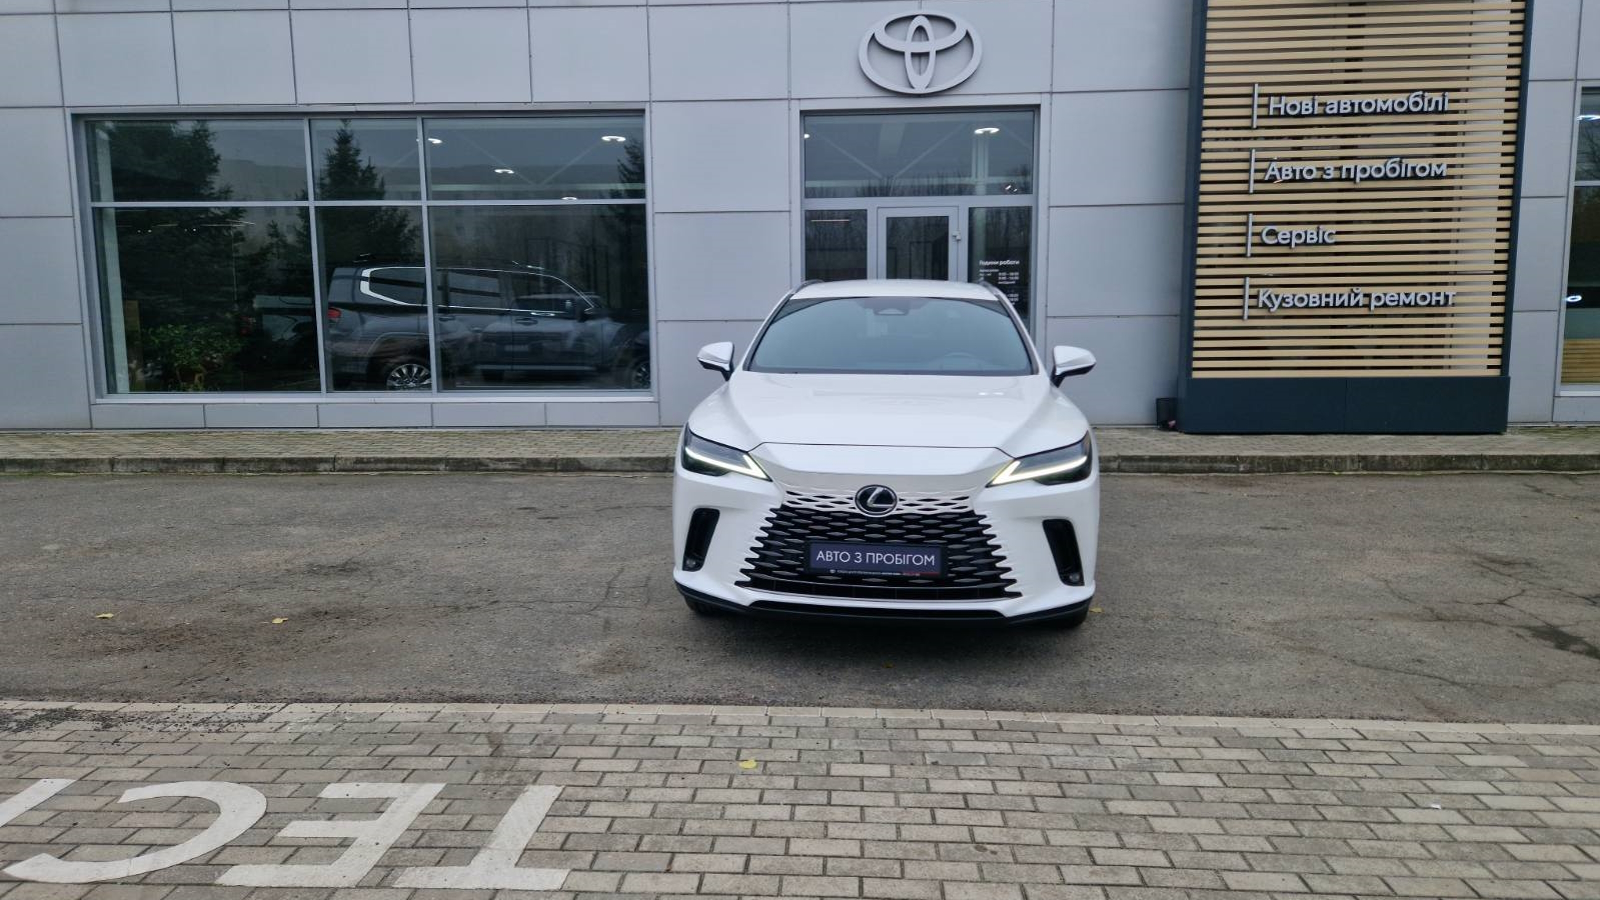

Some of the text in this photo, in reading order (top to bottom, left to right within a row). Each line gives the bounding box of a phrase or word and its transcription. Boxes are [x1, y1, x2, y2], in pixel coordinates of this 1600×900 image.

[1268, 91, 1449, 116] Нові автомобілі
[1264, 158, 1448, 183] Авто з пробігом
[1261, 225, 1337, 249] Сервіс
[1257, 287, 1456, 312] Кузовний ремонт
[816, 550, 936, 566] АВТО З ПРОБІГОМ
